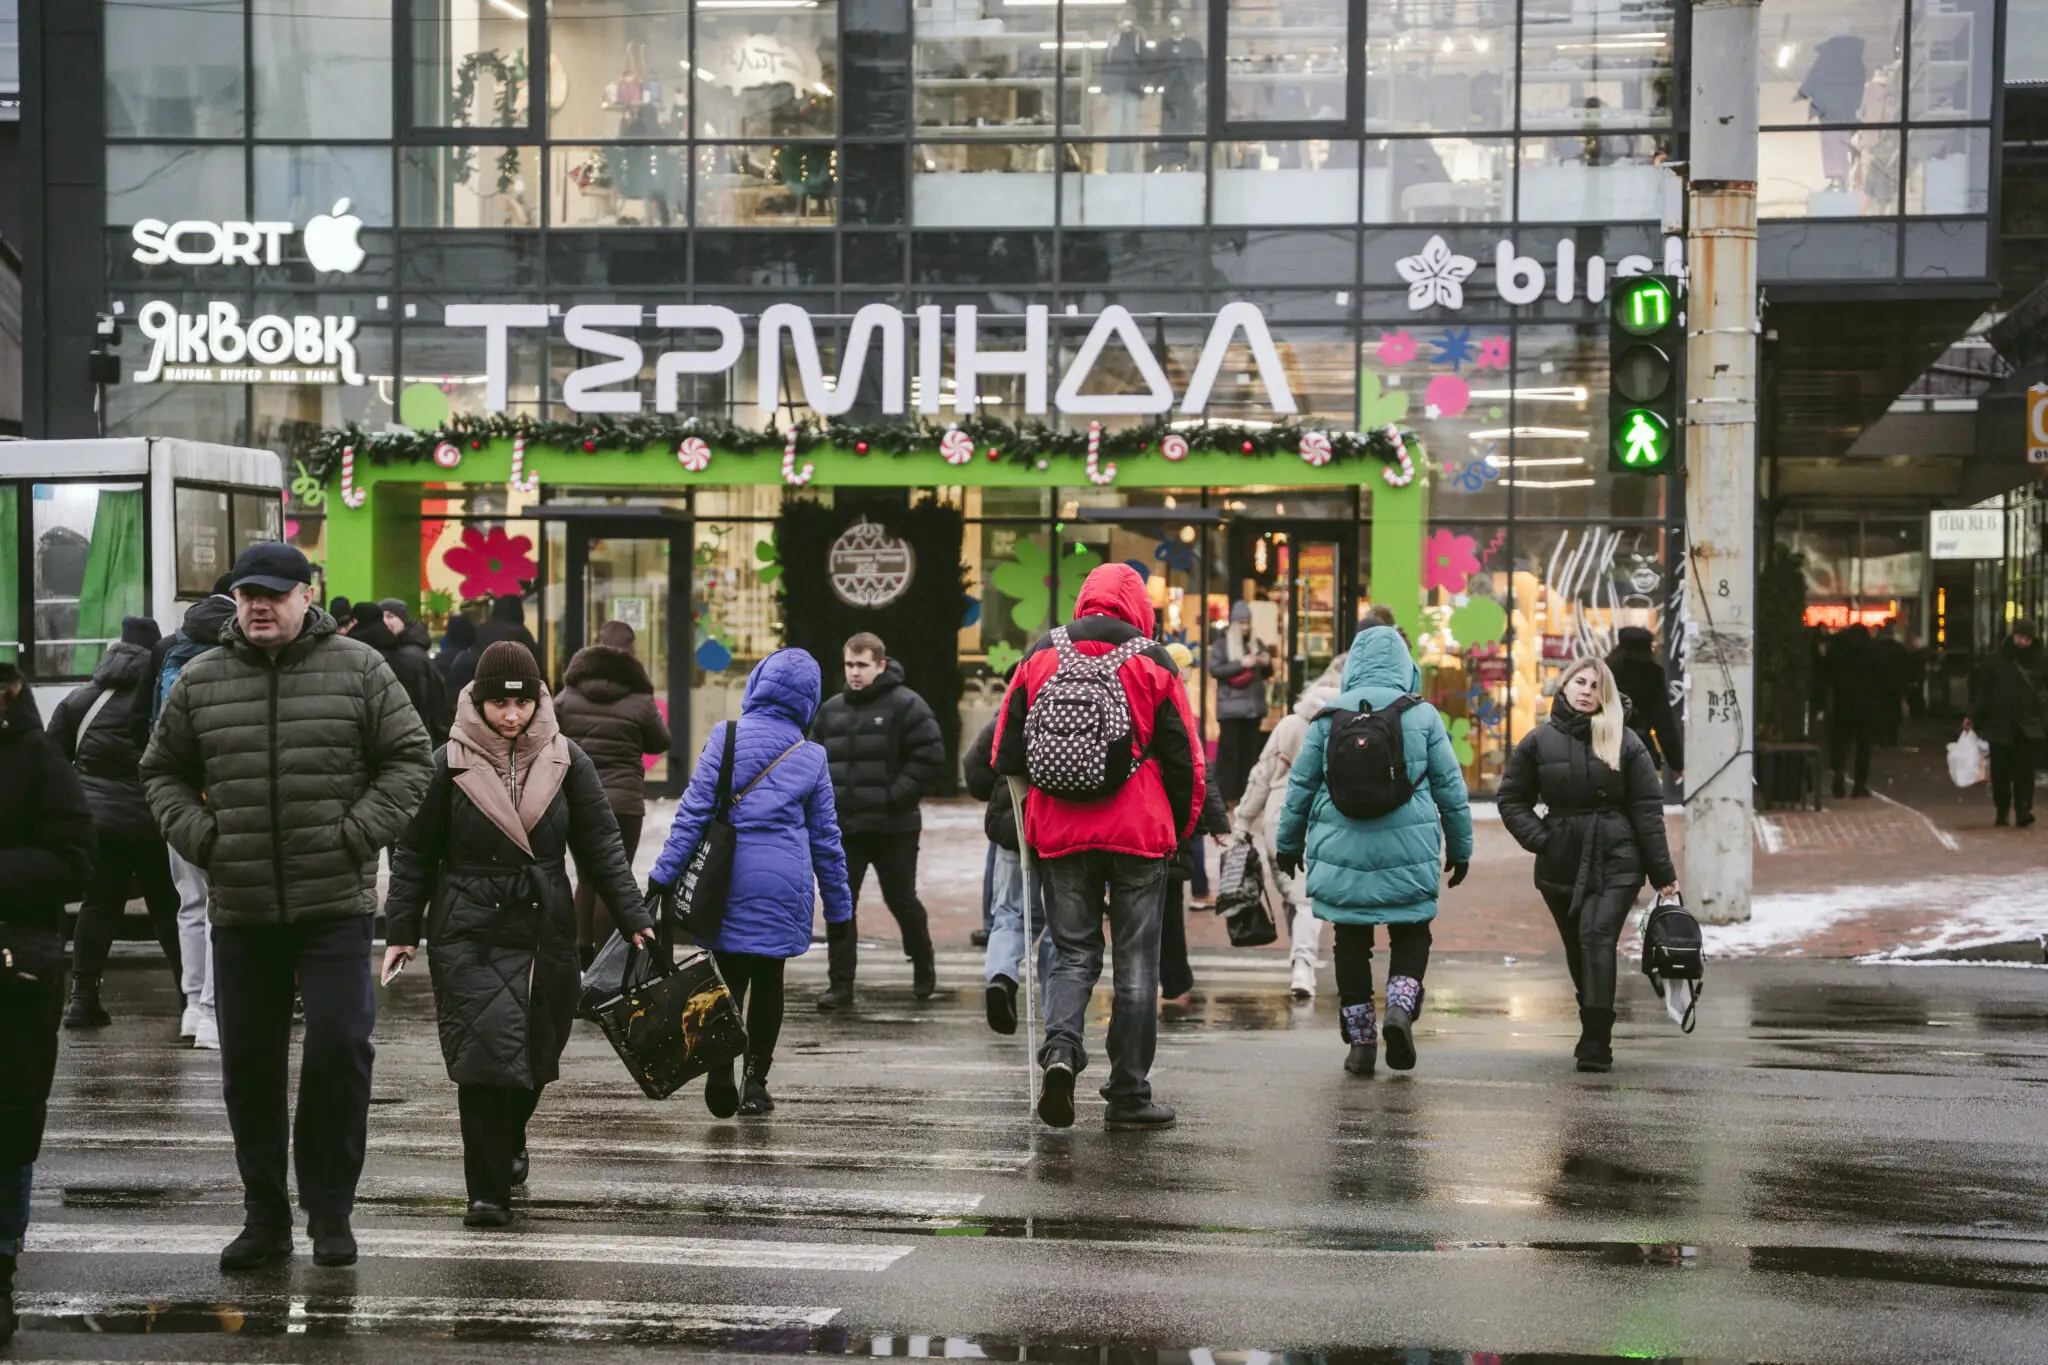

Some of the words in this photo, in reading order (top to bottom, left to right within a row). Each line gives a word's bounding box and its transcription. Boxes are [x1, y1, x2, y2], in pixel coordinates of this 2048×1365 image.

[132, 218, 294, 265] SORT
[1633, 289, 1665, 325] 17
[445, 302, 1298, 415] ТЕРМІНАЛ
[1718, 579, 1730, 597] 8
